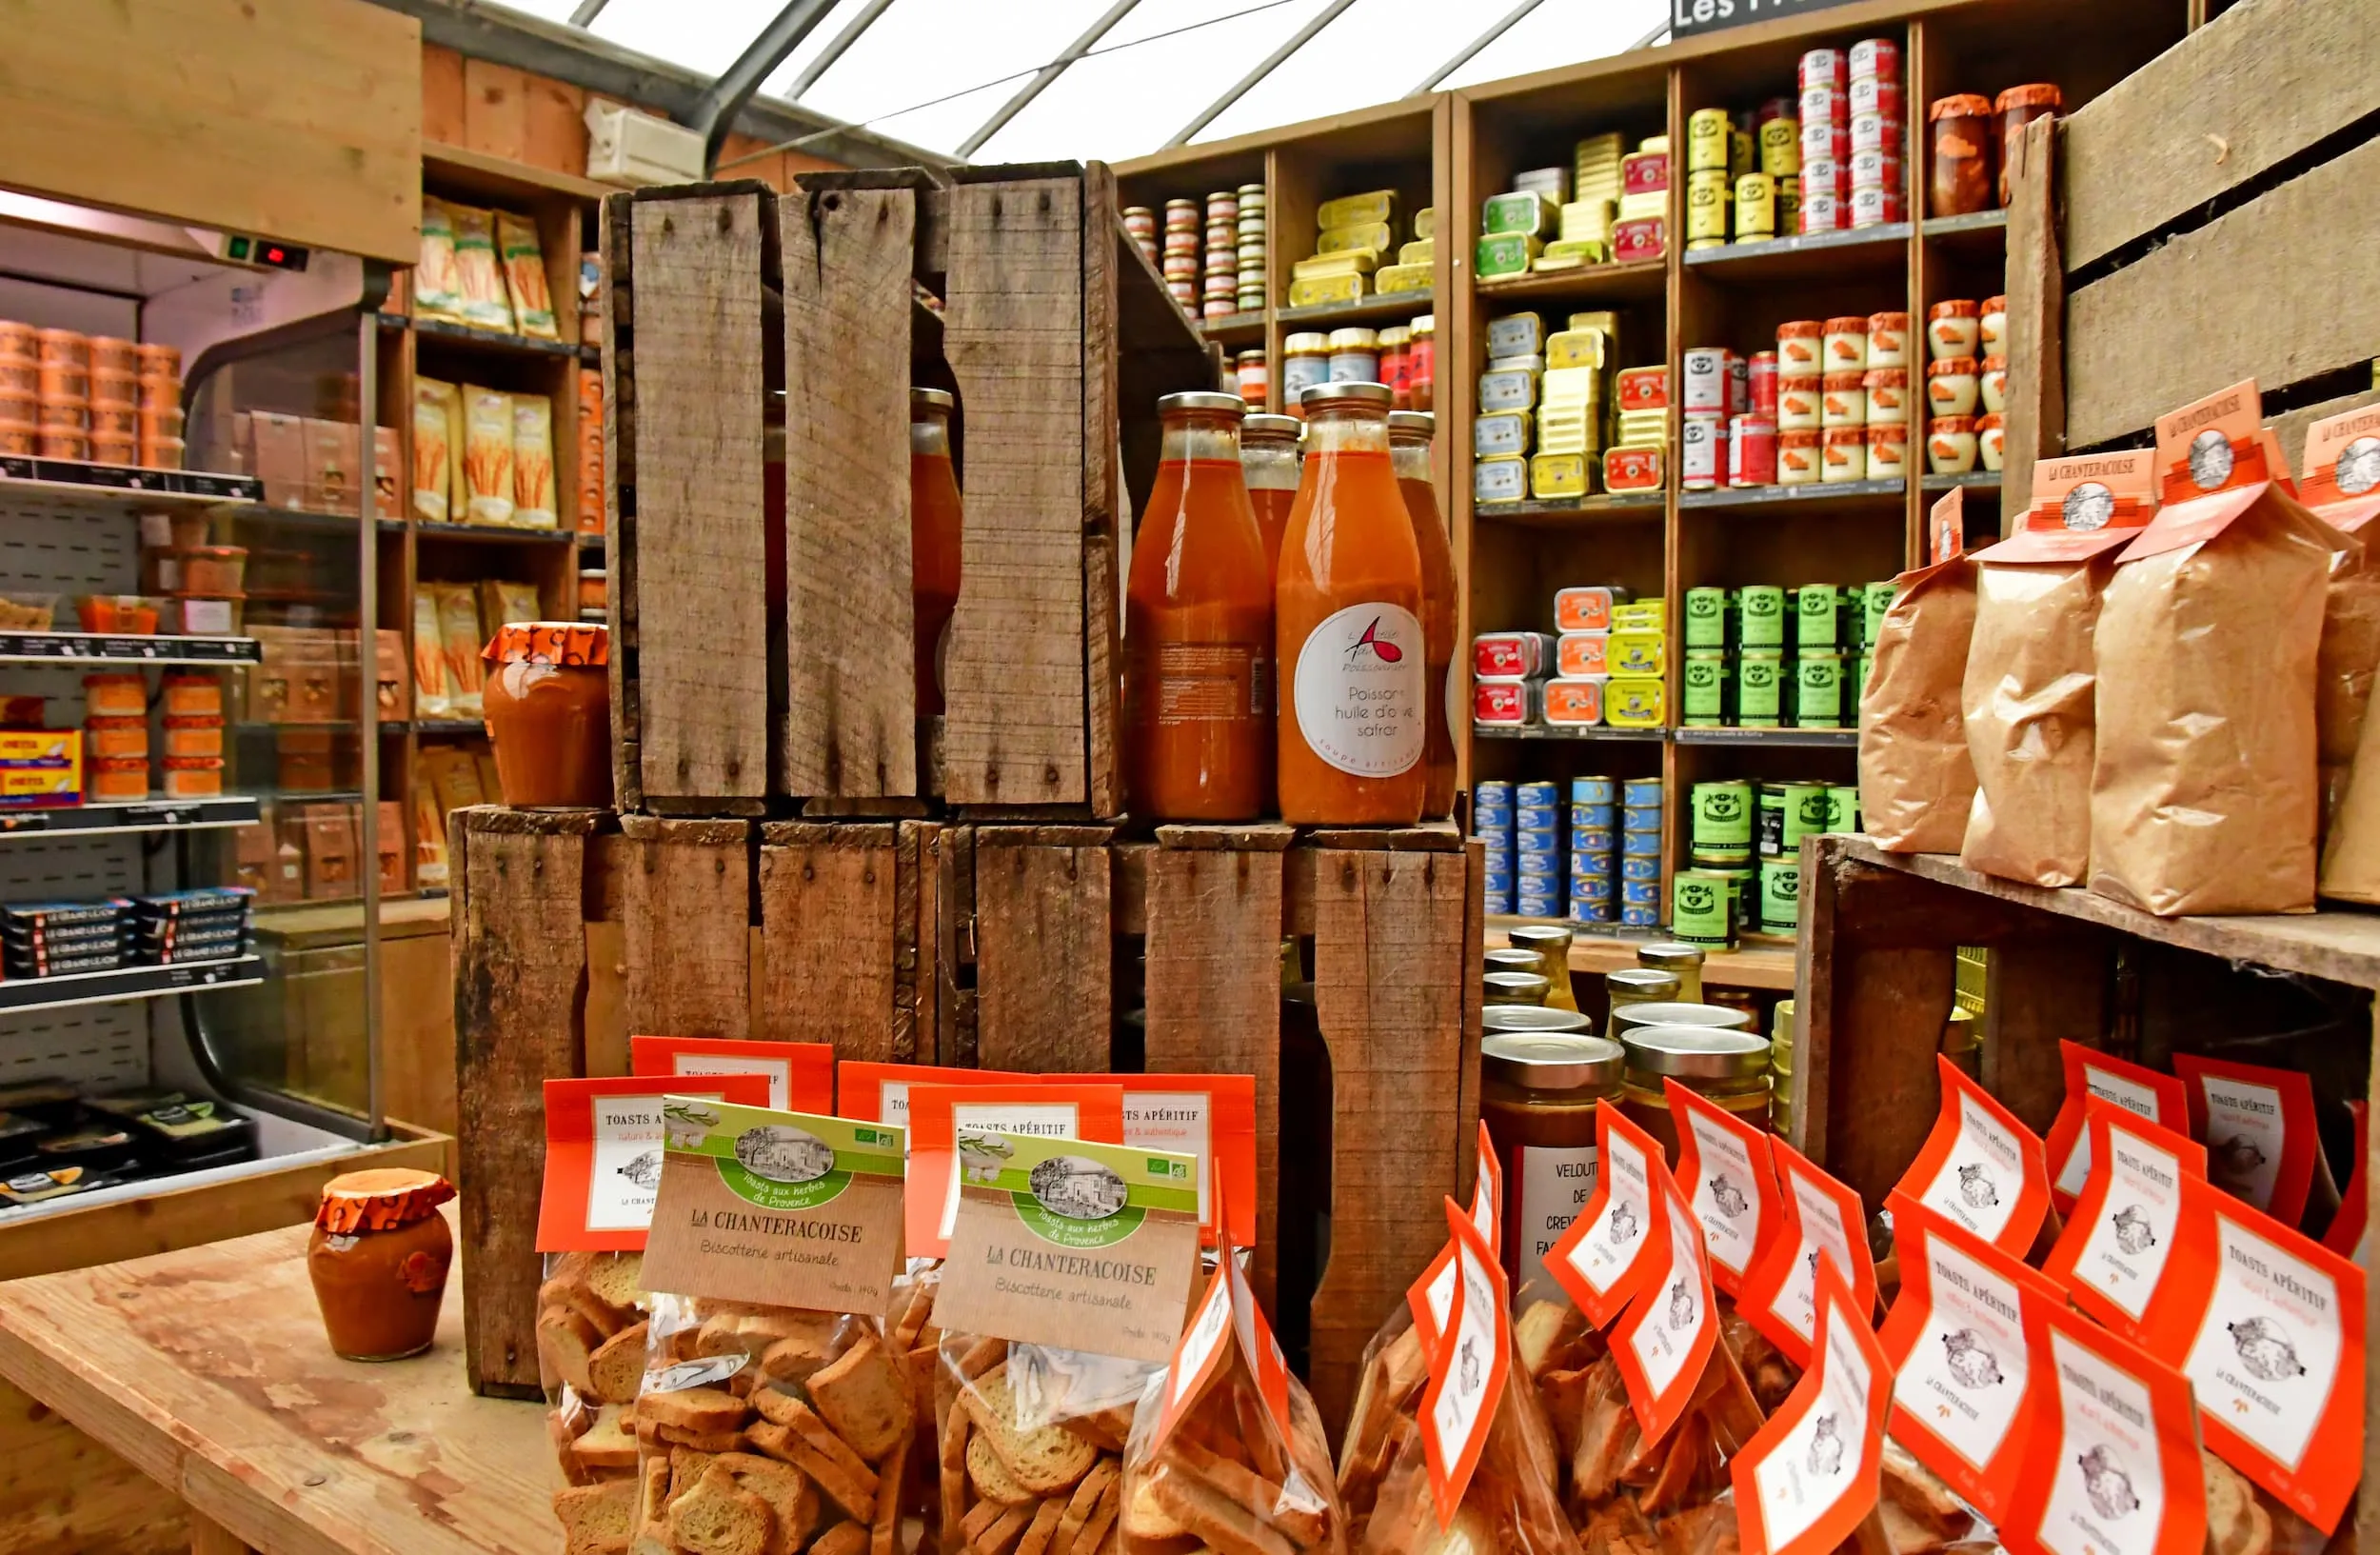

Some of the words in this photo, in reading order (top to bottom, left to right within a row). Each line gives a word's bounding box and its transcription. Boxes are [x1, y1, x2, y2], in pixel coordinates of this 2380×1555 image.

[1675, 0, 1735, 27] Les
[1335, 705, 1369, 720] huile
[605, 1113, 650, 1126] TOASTS
[1143, 1108, 1199, 1121] APÉRITIF
[1012, 1121, 1066, 1135] APÉRITIF
[1557, 1161, 1599, 1177] VELOUT
[743, 1172, 769, 1193] Toasts
[772, 1186, 790, 1197] aux
[793, 1180, 825, 1197] herbes
[753, 1193, 765, 1205] de
[768, 1193, 812, 1207] Provence
[1573, 1189, 1587, 1204] DE
[691, 1208, 708, 1226] LA
[714, 1211, 863, 1245] CHANTERACOISE
[1067, 1223, 1085, 1234] aux
[1087, 1217, 1120, 1234] herbes
[1546, 1215, 1578, 1229] CREV
[1048, 1229, 1061, 1241] de
[1063, 1230, 1105, 1245] Provence
[700, 1239, 768, 1259] Biscotterie
[773, 1248, 840, 1266] artisanale
[986, 1245, 1004, 1264] LA
[1009, 1247, 1157, 1286] CHANTERACOISE
[2229, 1245, 2269, 1278] TOASTS
[2272, 1268, 2328, 1311] APÉRITIF
[995, 1276, 1063, 1300] Biscotterie
[1068, 1288, 1133, 1309] artisanale
[1973, 1286, 2019, 1323] APÉRITIF
